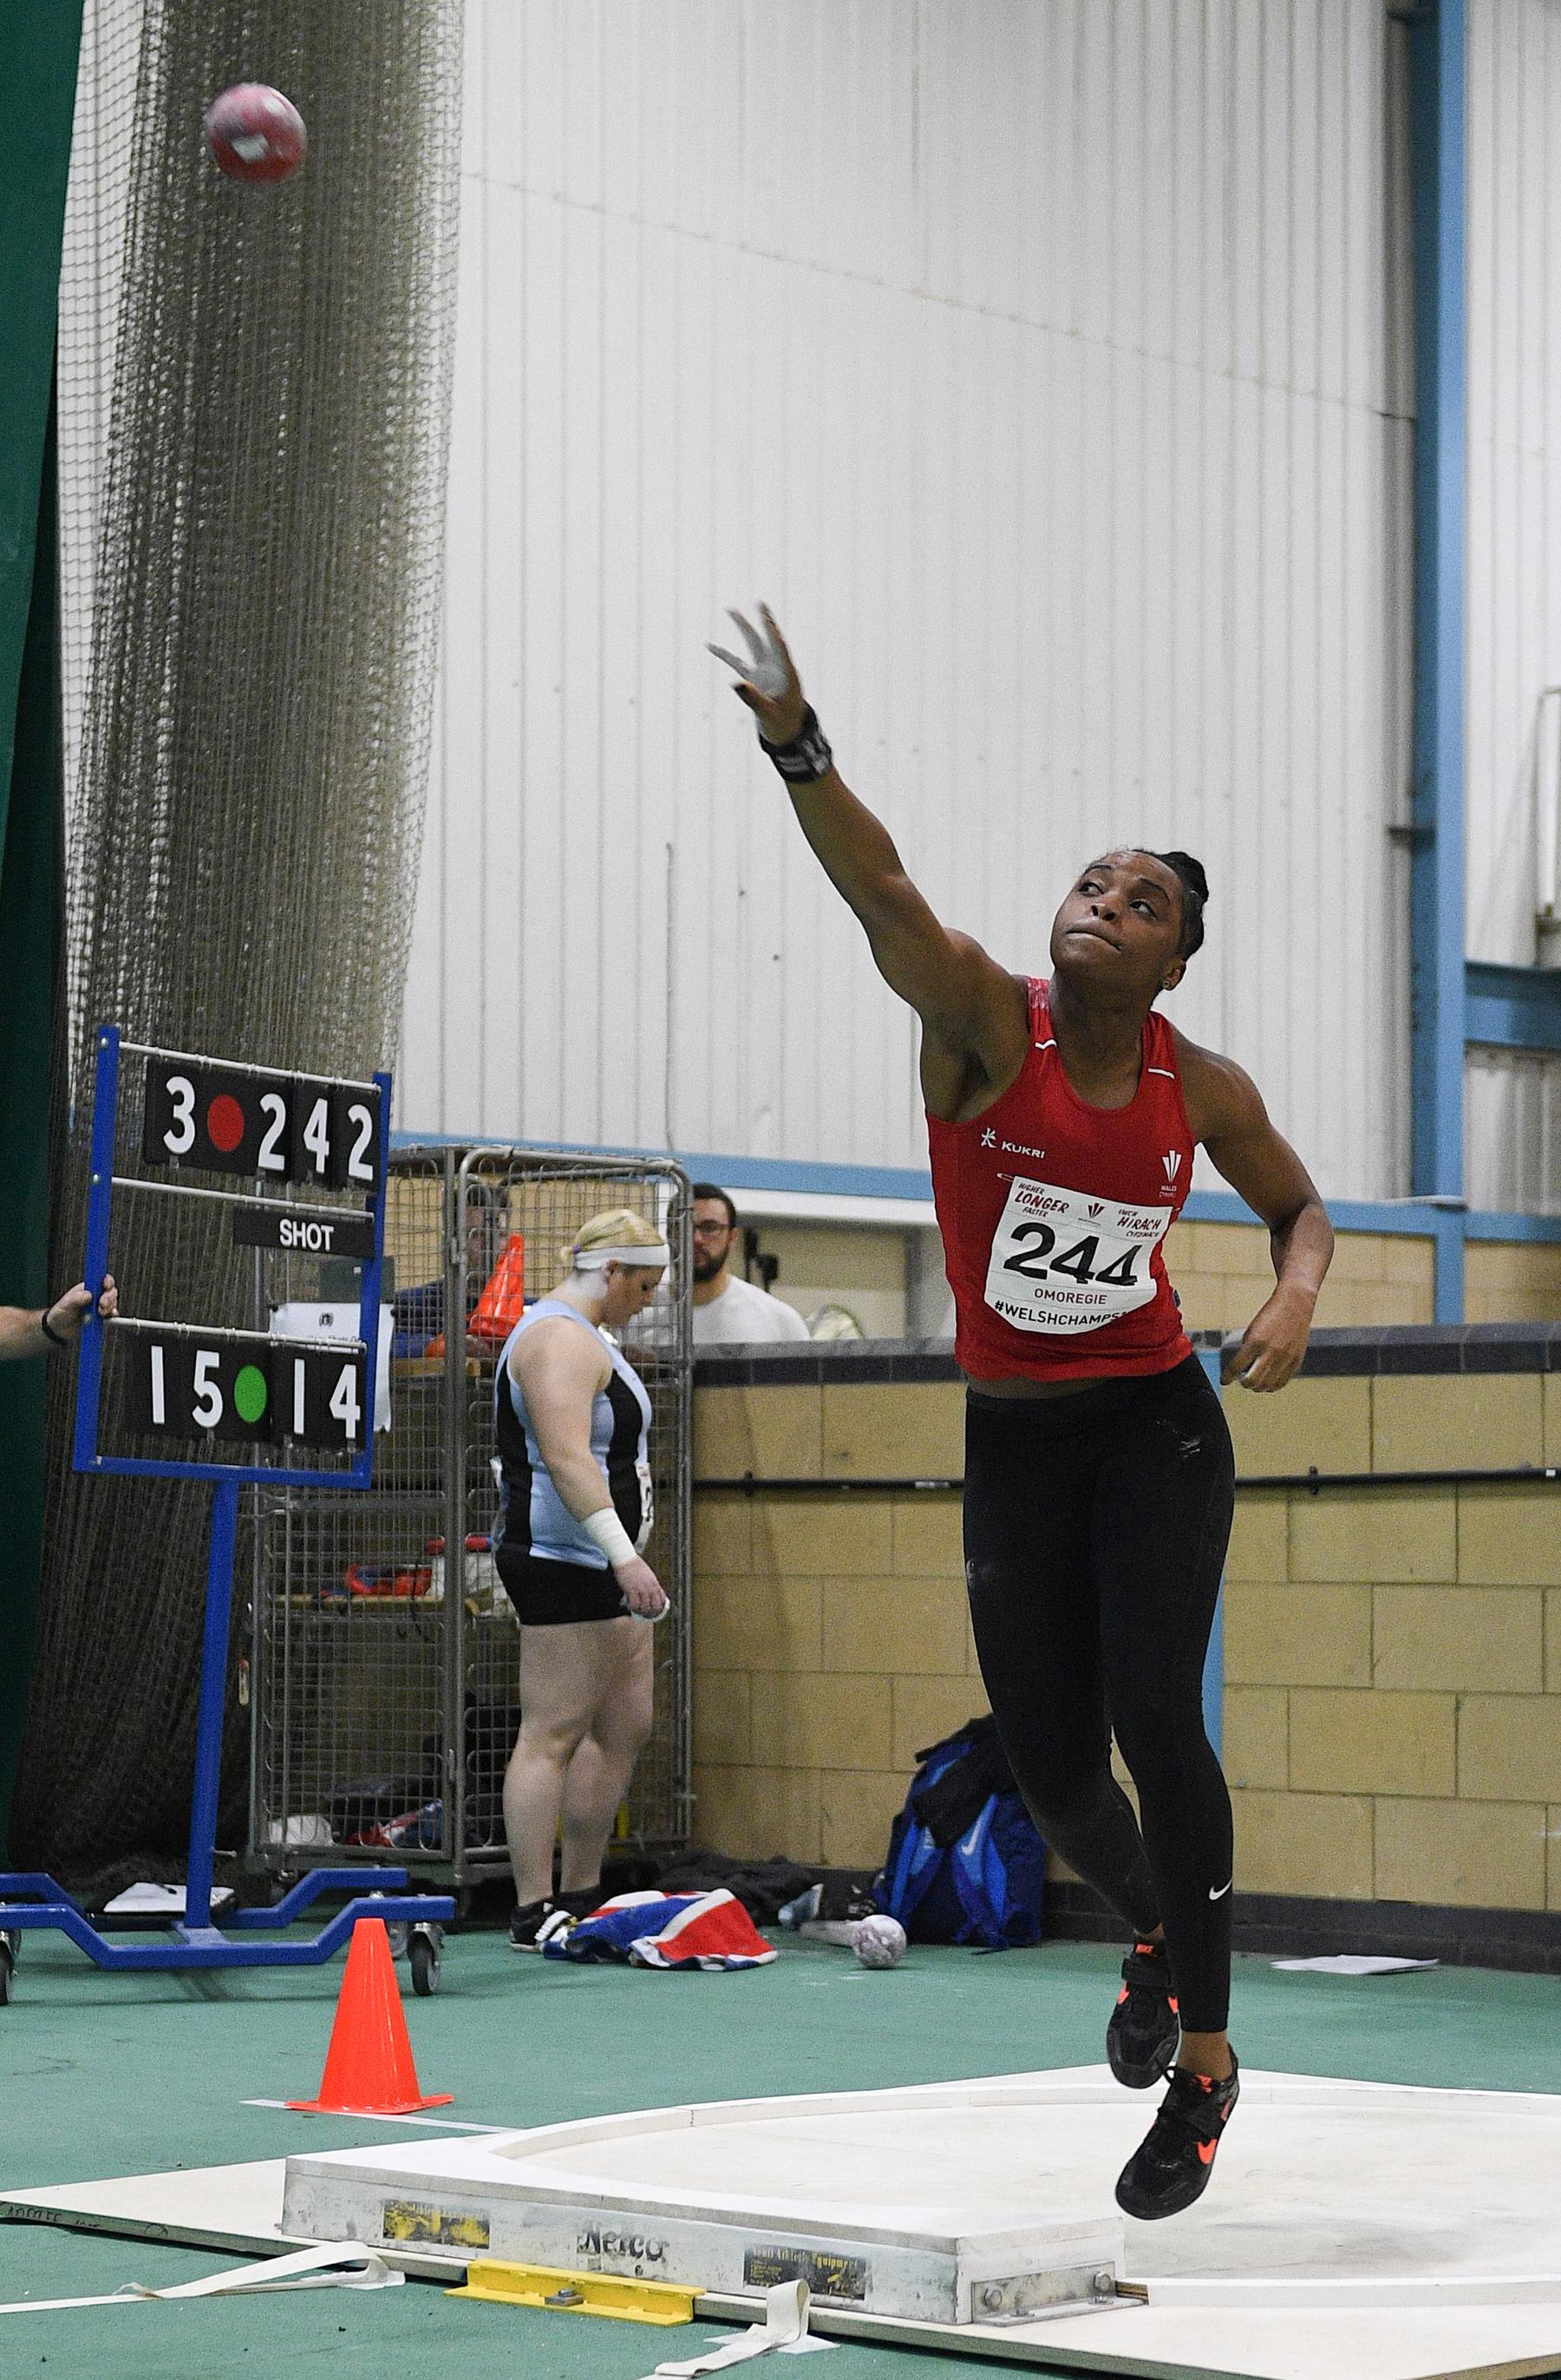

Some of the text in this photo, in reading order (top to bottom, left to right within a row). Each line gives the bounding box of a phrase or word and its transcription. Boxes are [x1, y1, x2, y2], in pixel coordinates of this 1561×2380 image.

[1001, 1141, 1046, 1159] KUKRI
[1018, 1182, 1045, 1196] HIGHER
[1015, 1191, 1069, 1213] LONGER
[1022, 1206, 1048, 1218] FASTER
[1117, 1216, 1163, 1231] HIRACH
[279, 1219, 335, 1251] SHOT
[1003, 1221, 1143, 1286] 244
[1034, 1288, 1107, 1305] OMOREGIE
[995, 1300, 1127, 1325] #WELSHCHAMPS
